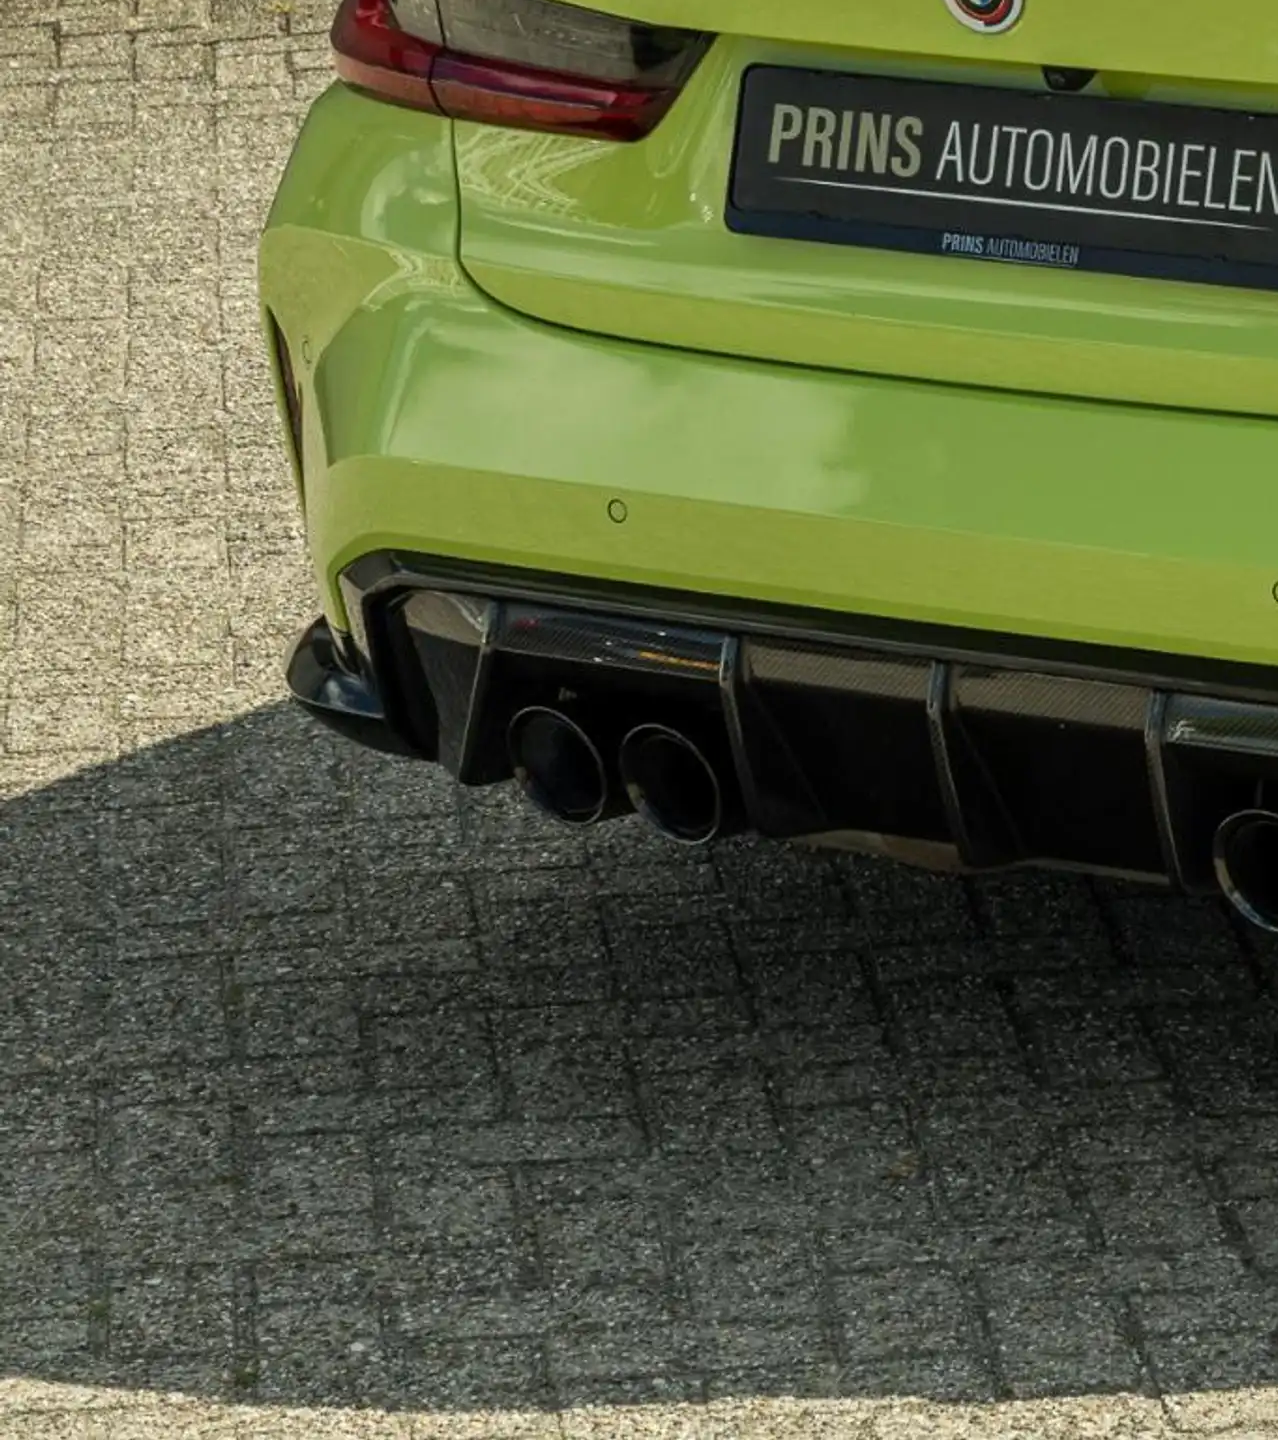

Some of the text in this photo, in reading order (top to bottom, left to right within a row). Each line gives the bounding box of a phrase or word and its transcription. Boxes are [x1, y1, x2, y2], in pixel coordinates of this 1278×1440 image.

[767, 103, 925, 178] PRINS
[942, 231, 1081, 266] PRINS AUTOMOBIELEN
